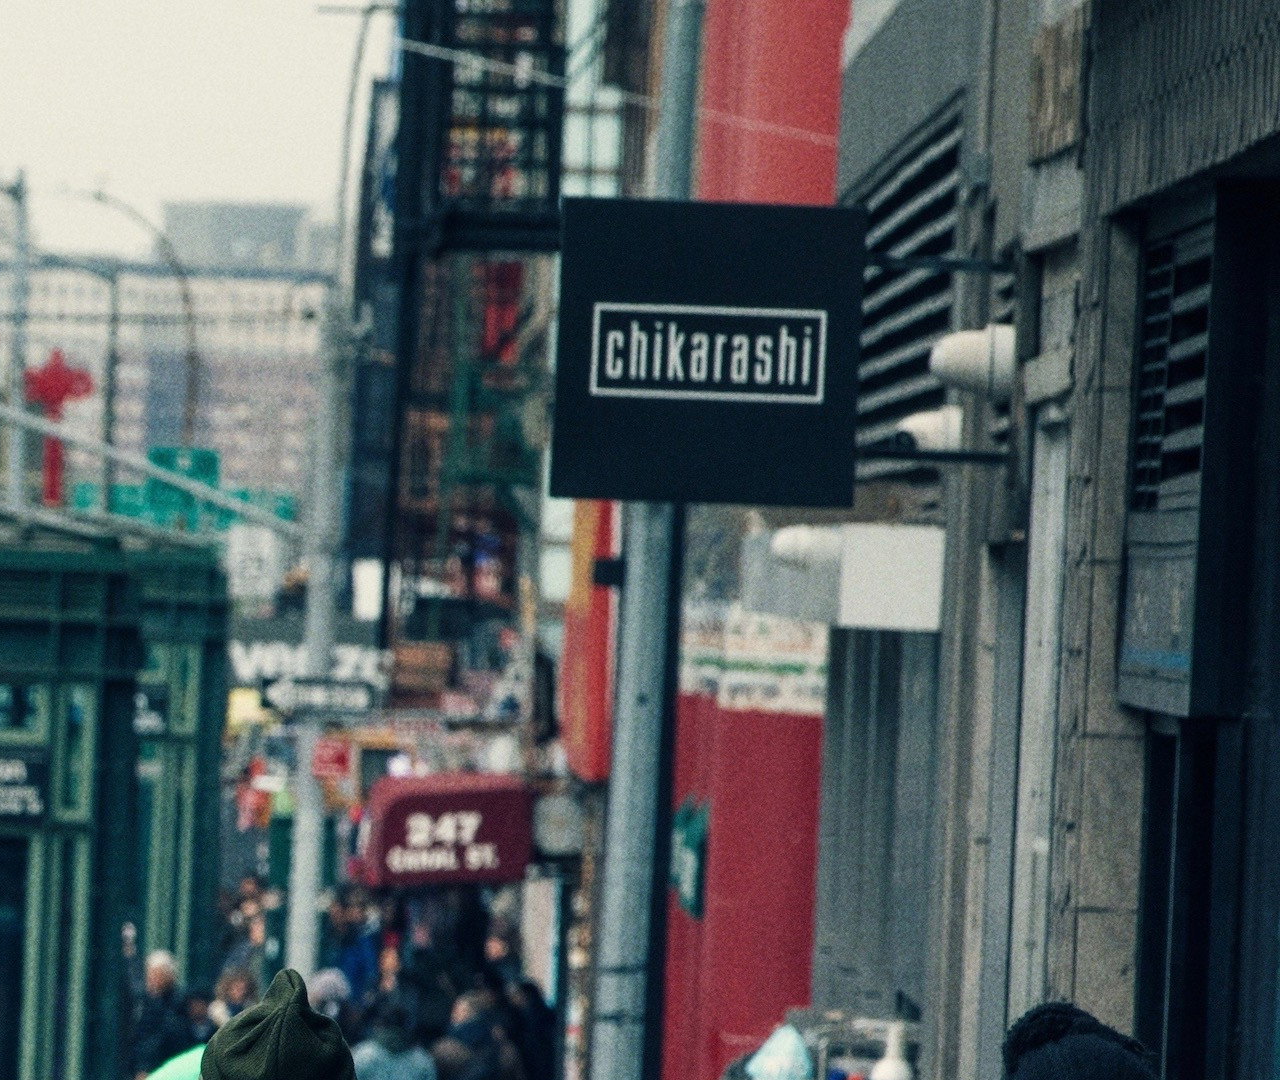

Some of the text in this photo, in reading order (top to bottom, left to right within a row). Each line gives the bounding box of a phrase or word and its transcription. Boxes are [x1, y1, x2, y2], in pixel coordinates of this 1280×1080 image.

[604, 319, 813, 386] chikarashi
[404, 811, 484, 851] 247
[386, 845, 459, 873] CANAL
